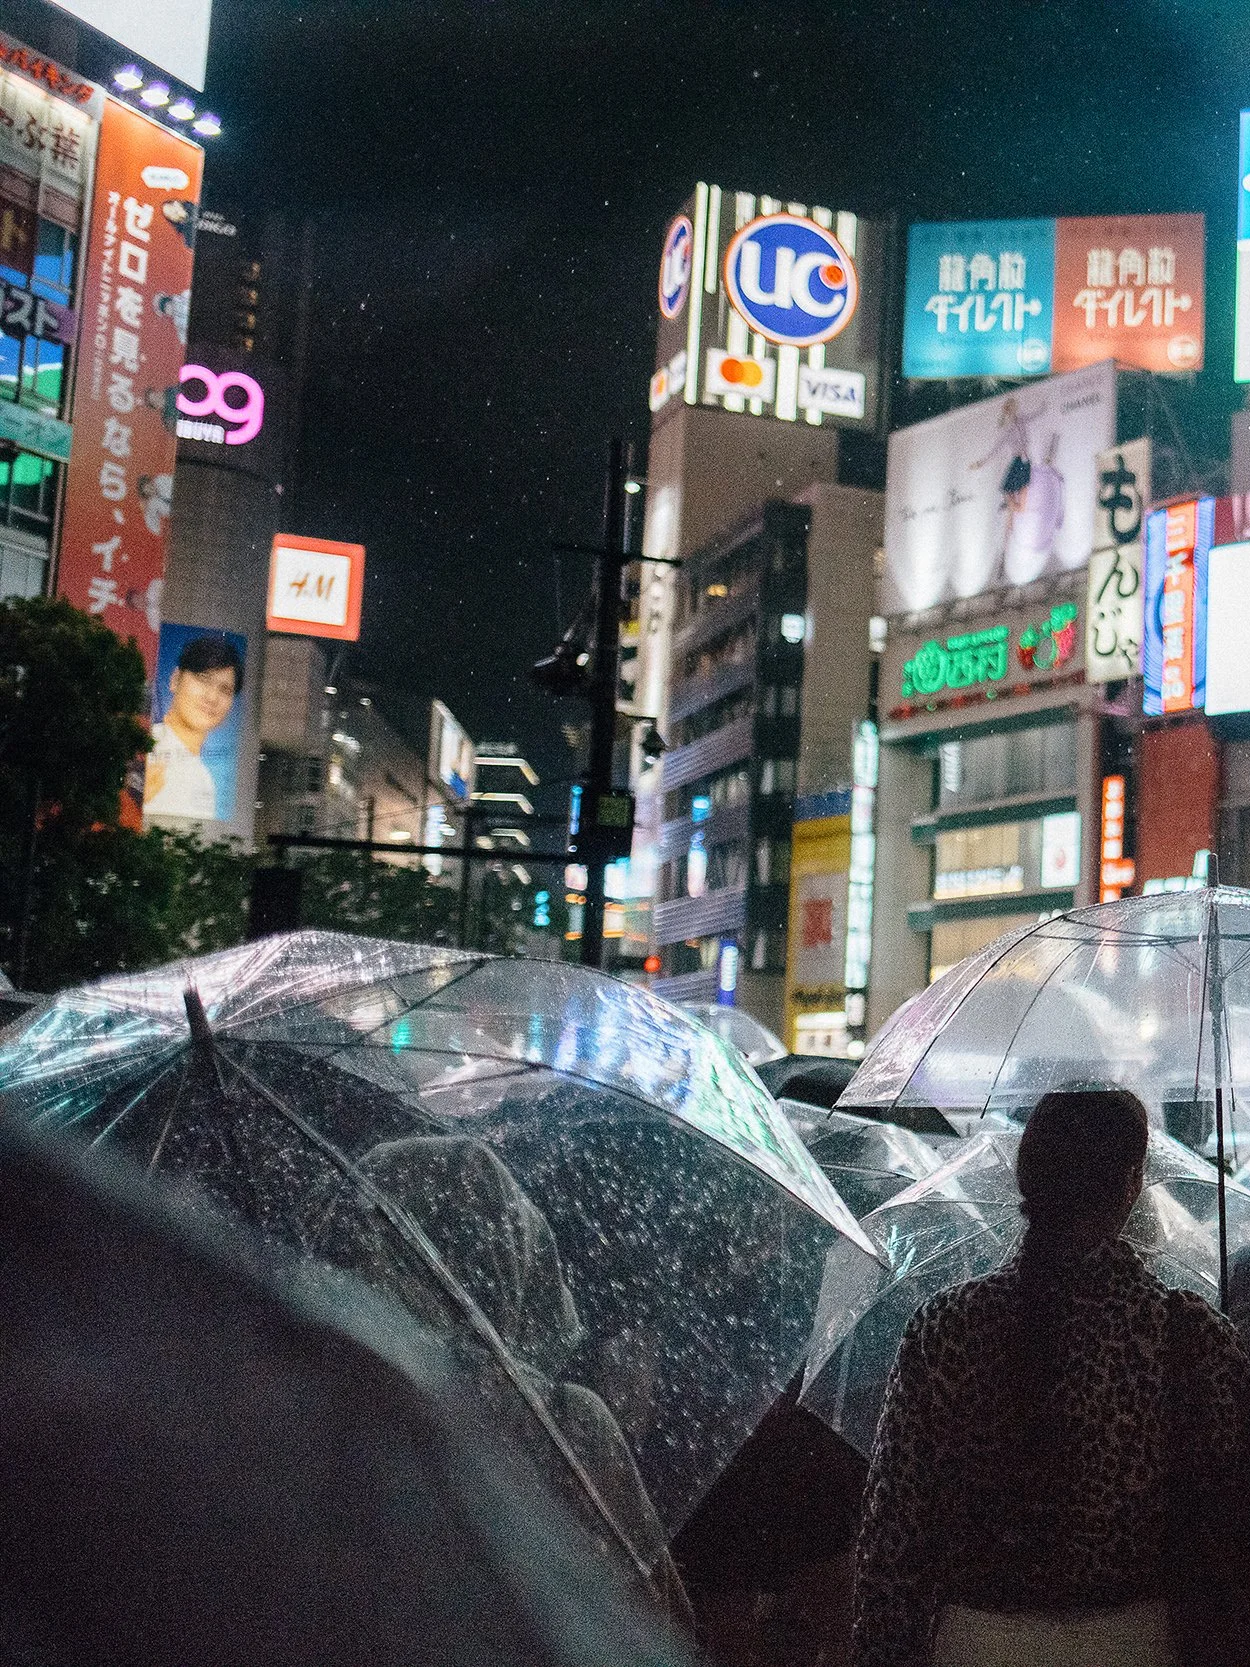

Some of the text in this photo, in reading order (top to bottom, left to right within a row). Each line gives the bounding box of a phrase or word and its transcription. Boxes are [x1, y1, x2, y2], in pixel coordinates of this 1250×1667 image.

[740, 239, 846, 318] UC
[176, 364, 265, 445] 09
[805, 379, 856, 401] VISA
[1094, 453, 1142, 670] もんじゃ
